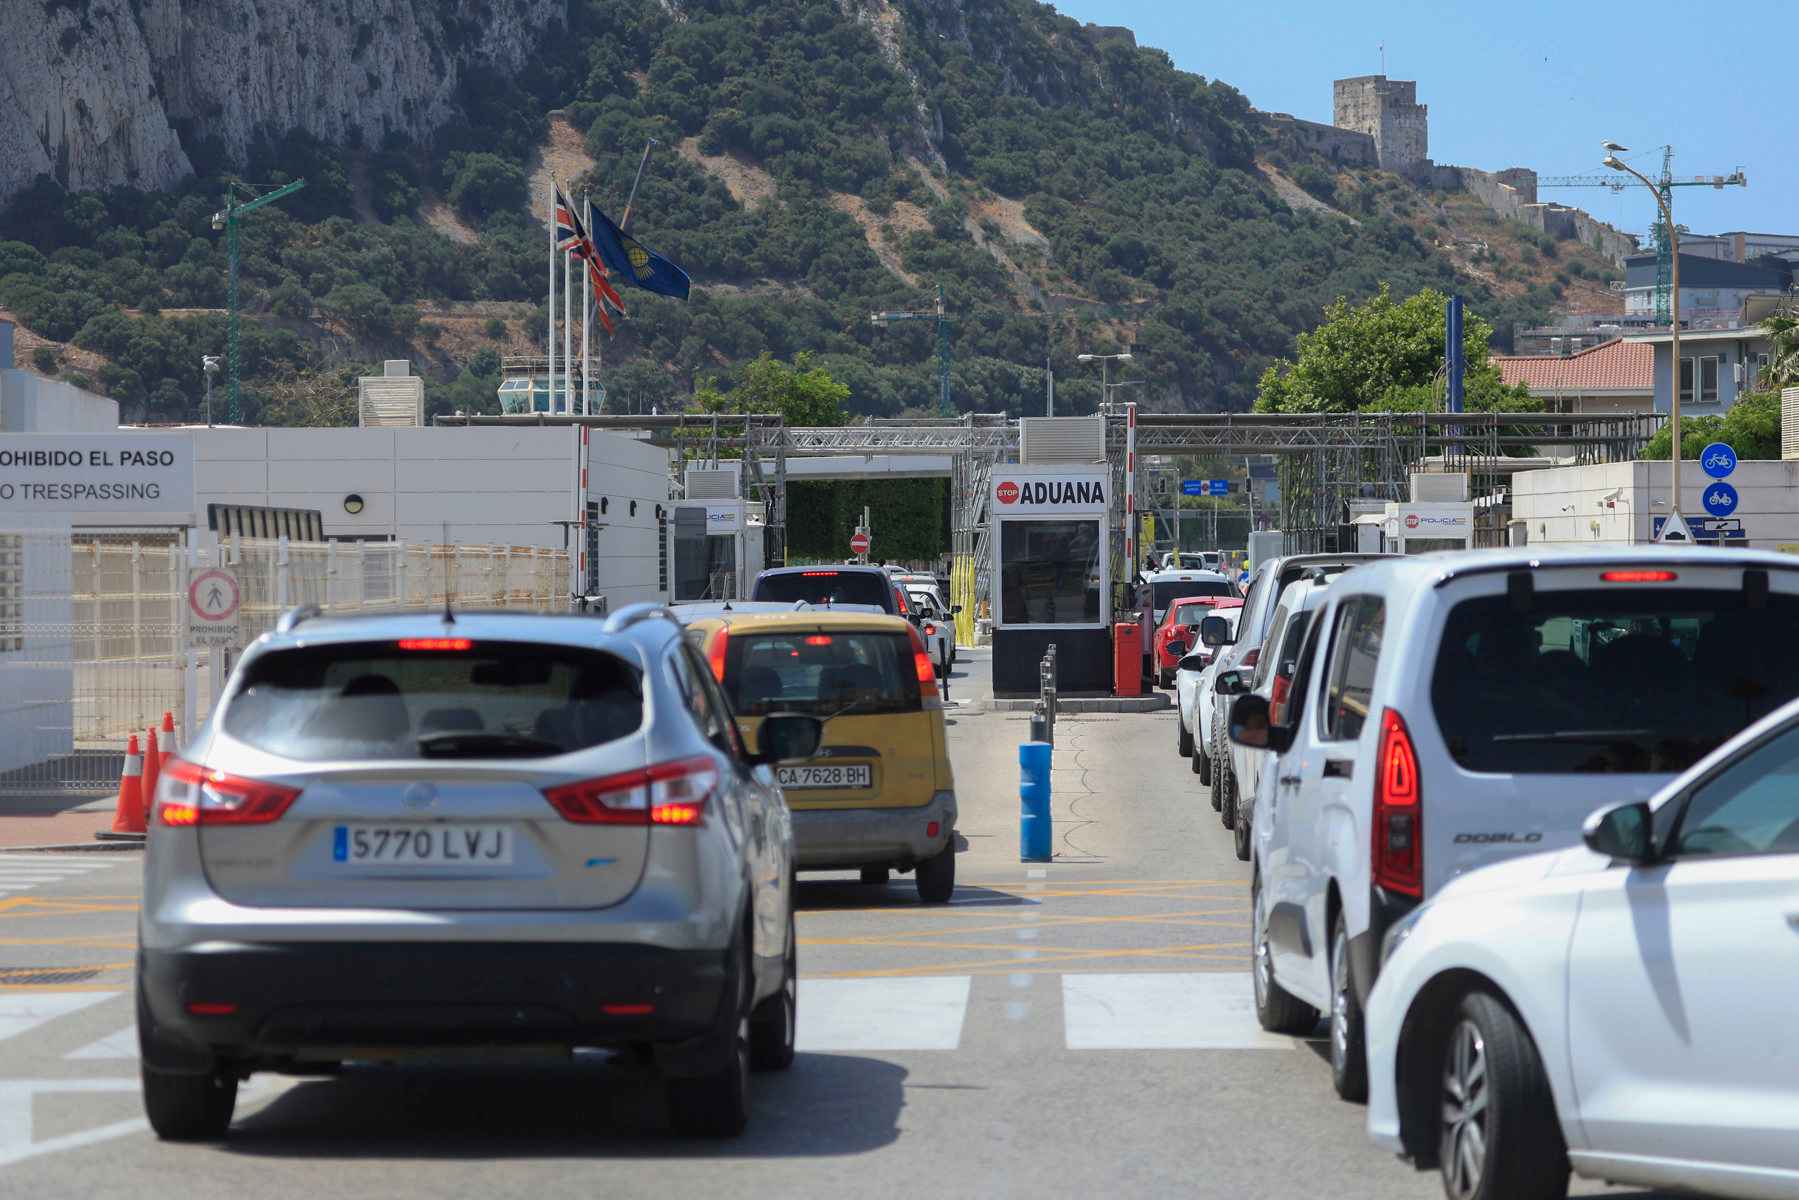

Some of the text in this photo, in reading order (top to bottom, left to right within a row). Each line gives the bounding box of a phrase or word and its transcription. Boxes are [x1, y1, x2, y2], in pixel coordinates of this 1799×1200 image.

[89, 451, 113, 467] EL
[119, 451, 175, 467] PASO
[20, 484, 161, 500] TRESPASSING
[998, 481, 1105, 505] STOP ADUANA
[353, 829, 504, 860] 5770 LVJ
[1453, 832, 1543, 844] DOBLO
